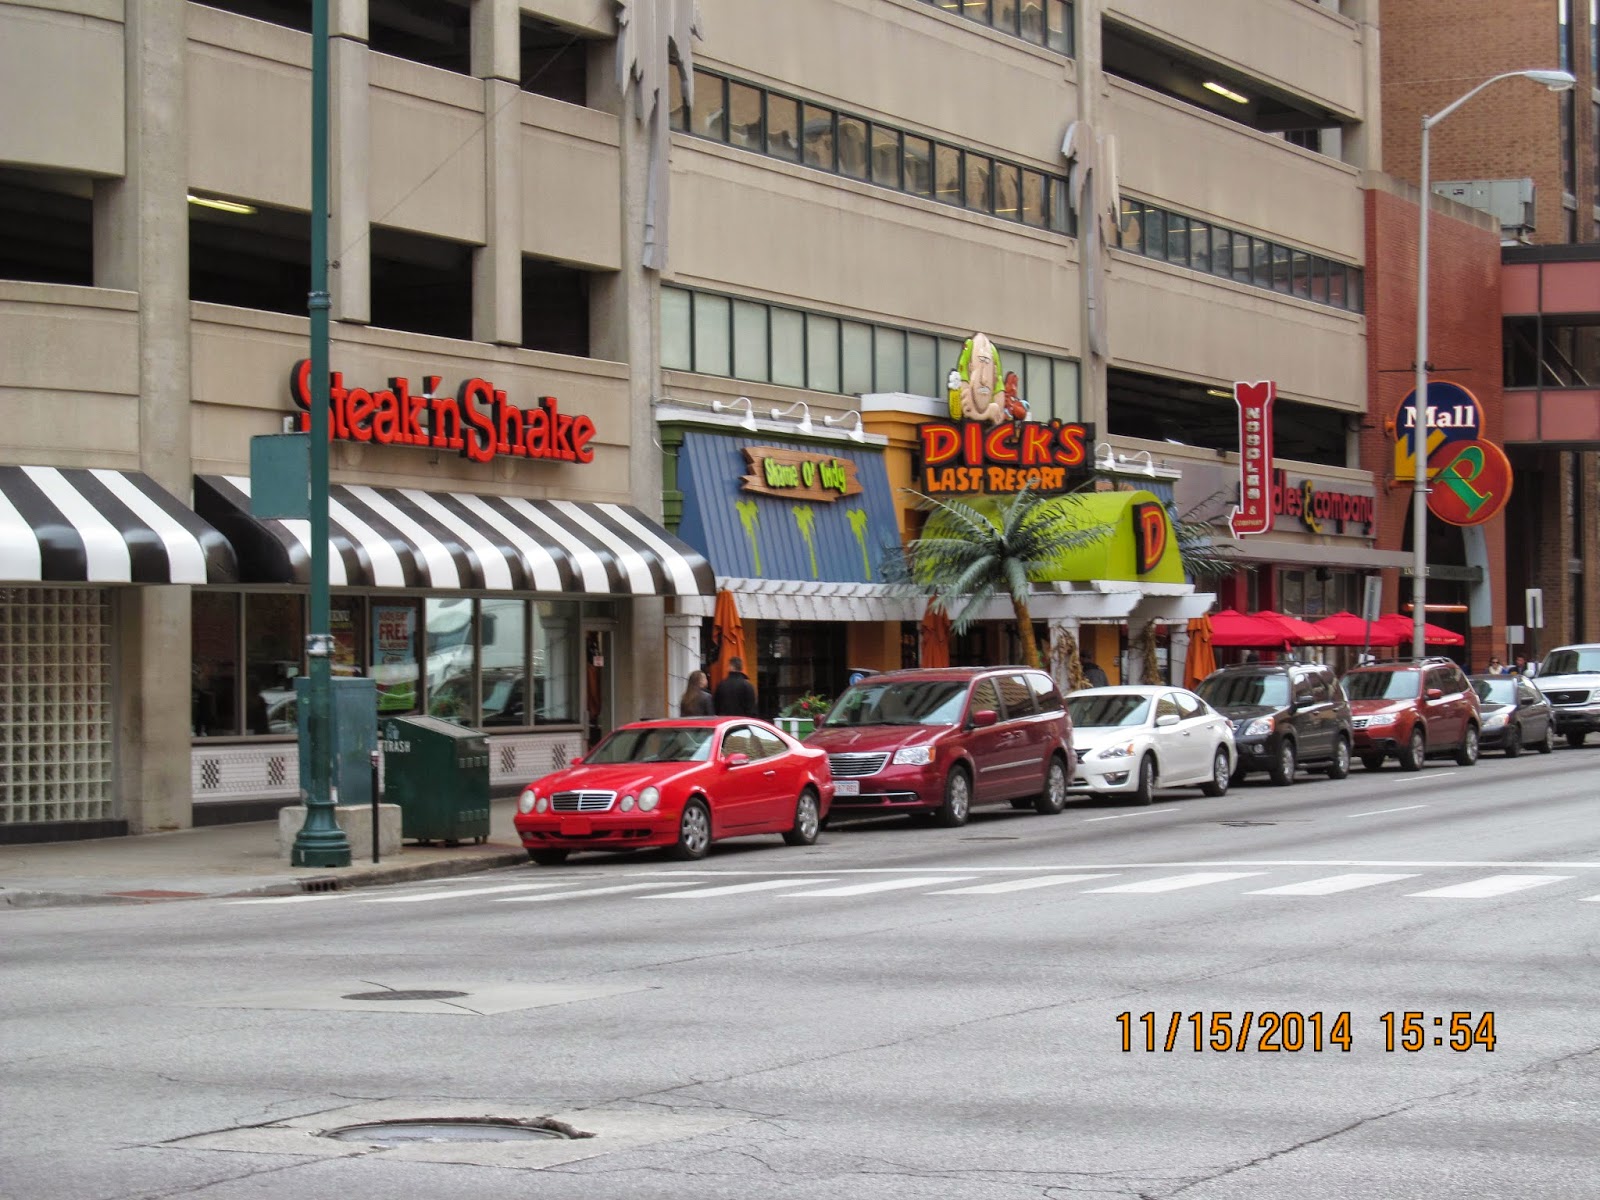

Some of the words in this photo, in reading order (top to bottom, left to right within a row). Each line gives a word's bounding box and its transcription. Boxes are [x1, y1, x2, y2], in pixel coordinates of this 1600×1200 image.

[460, 377, 596, 464] Shake
[1404, 405, 1476, 428] Mall
[920, 421, 1087, 466] DICK'S
[819, 458, 847, 494] Indy
[926, 467, 983, 492] LAST
[987, 466, 1066, 492] RESORT
[1433, 445, 1493, 518] P
[1314, 490, 1375, 536] company
[1137, 503, 1167, 572] D
[384, 740, 411, 753] TRASH
